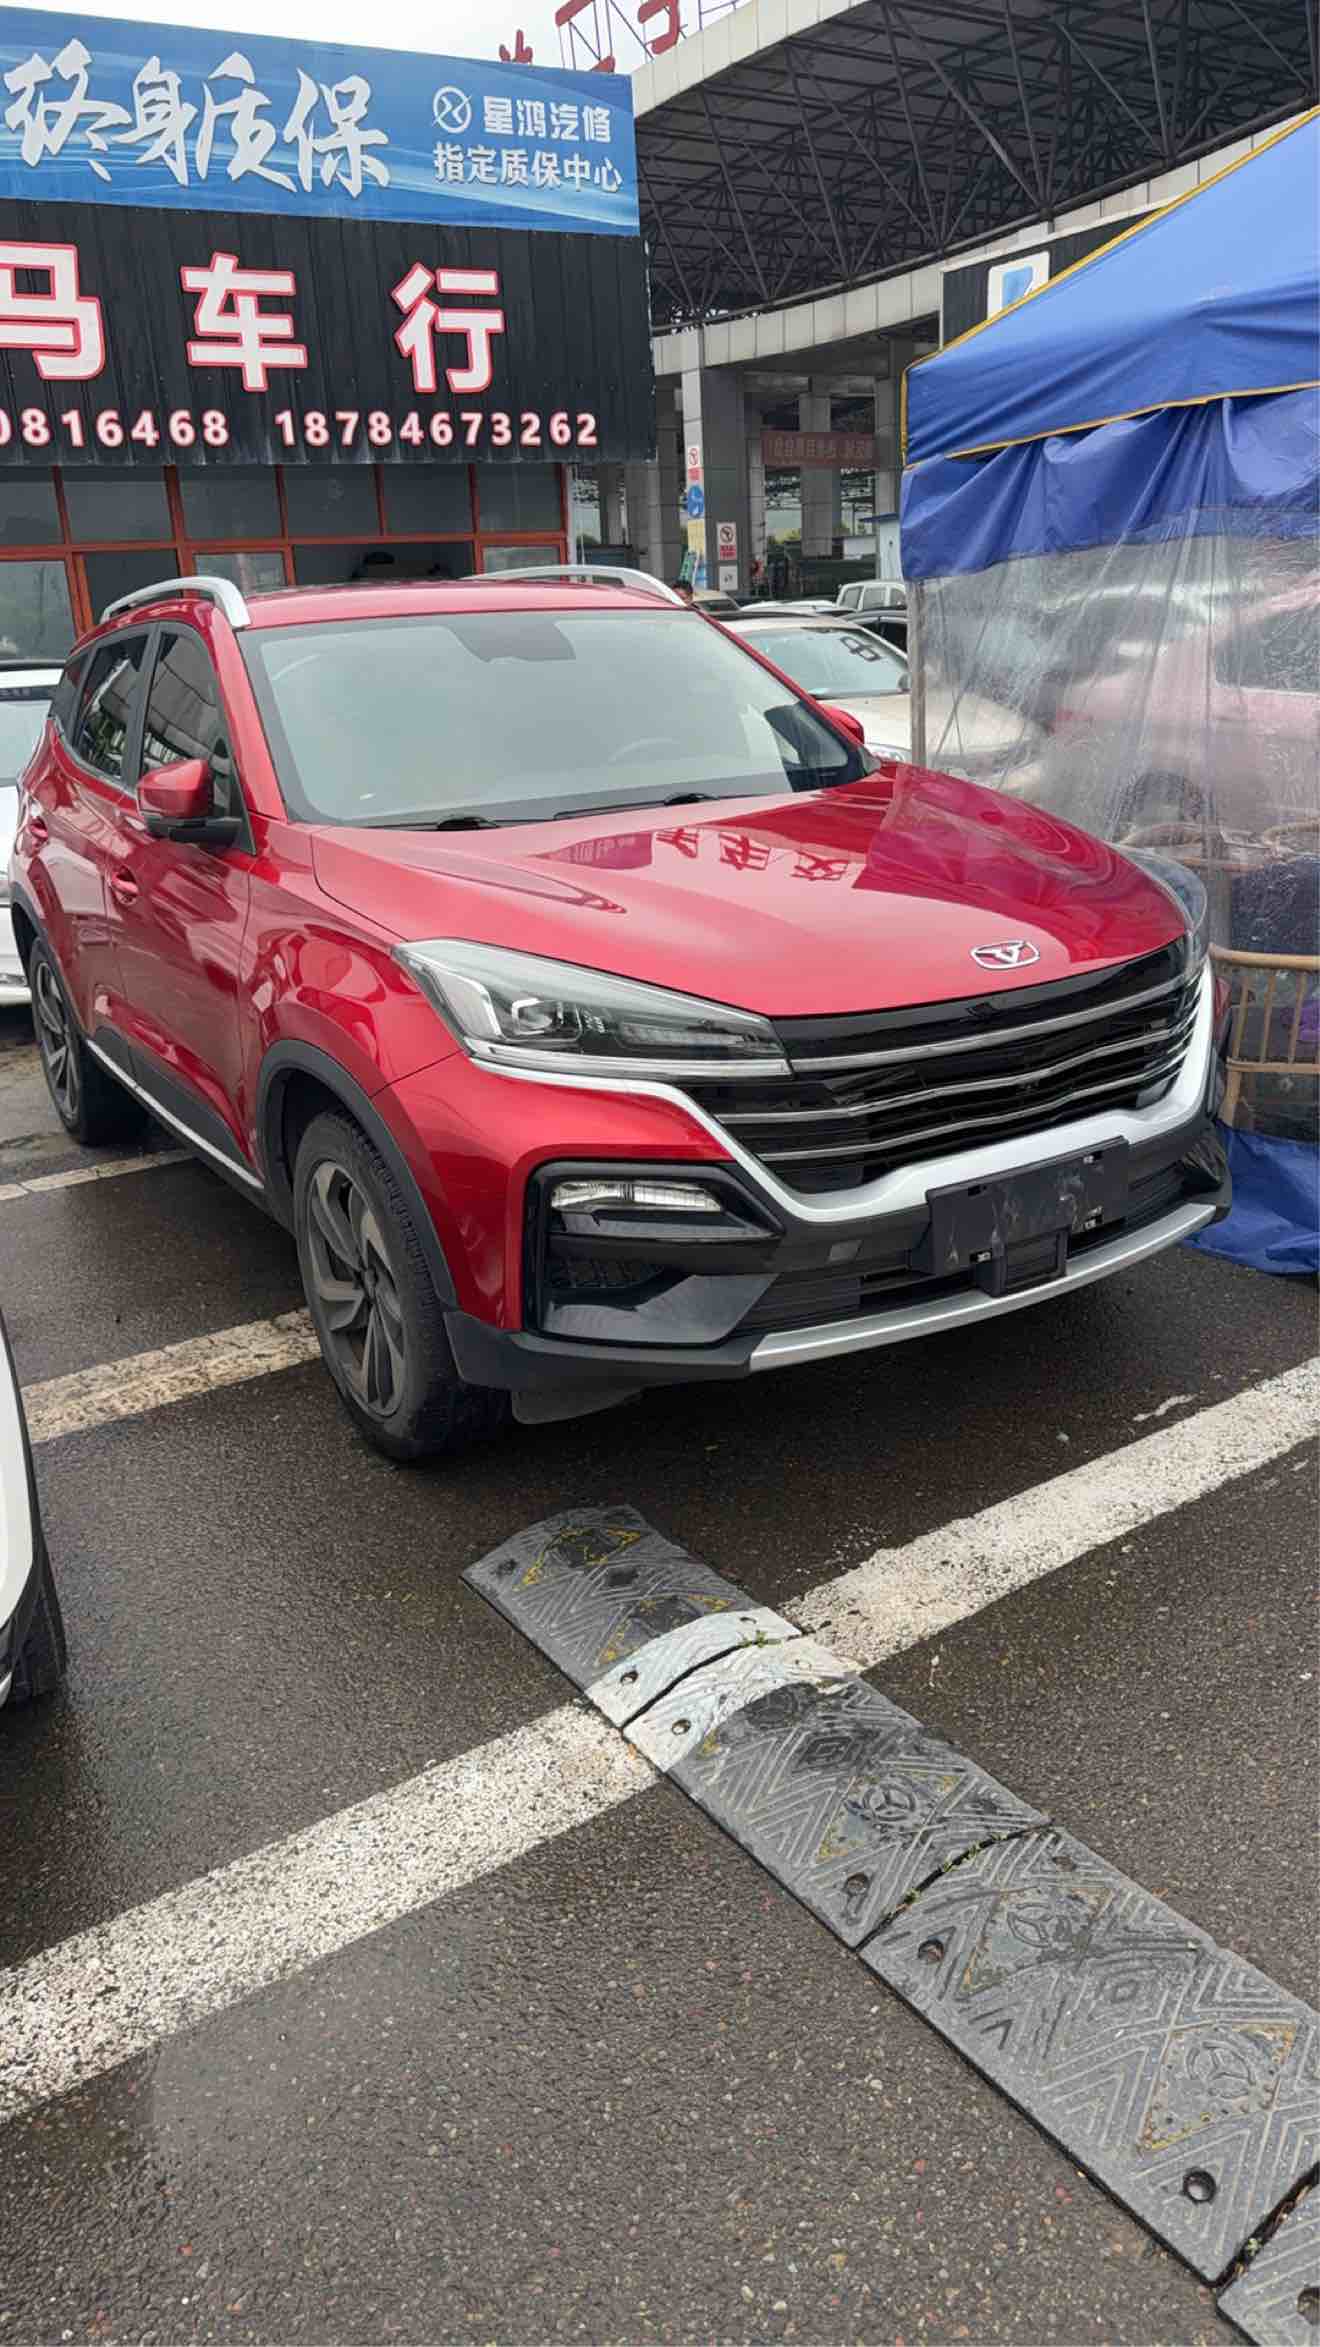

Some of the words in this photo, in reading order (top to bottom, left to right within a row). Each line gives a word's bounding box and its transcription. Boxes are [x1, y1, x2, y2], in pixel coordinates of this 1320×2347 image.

[3, 37, 390, 199] 终身质保
[483, 95, 612, 143] 星鸿汽修
[432, 143, 623, 193] 指定质保中心
[0, 240, 504, 393] 马车行
[275, 410, 599, 447] 18784673262
